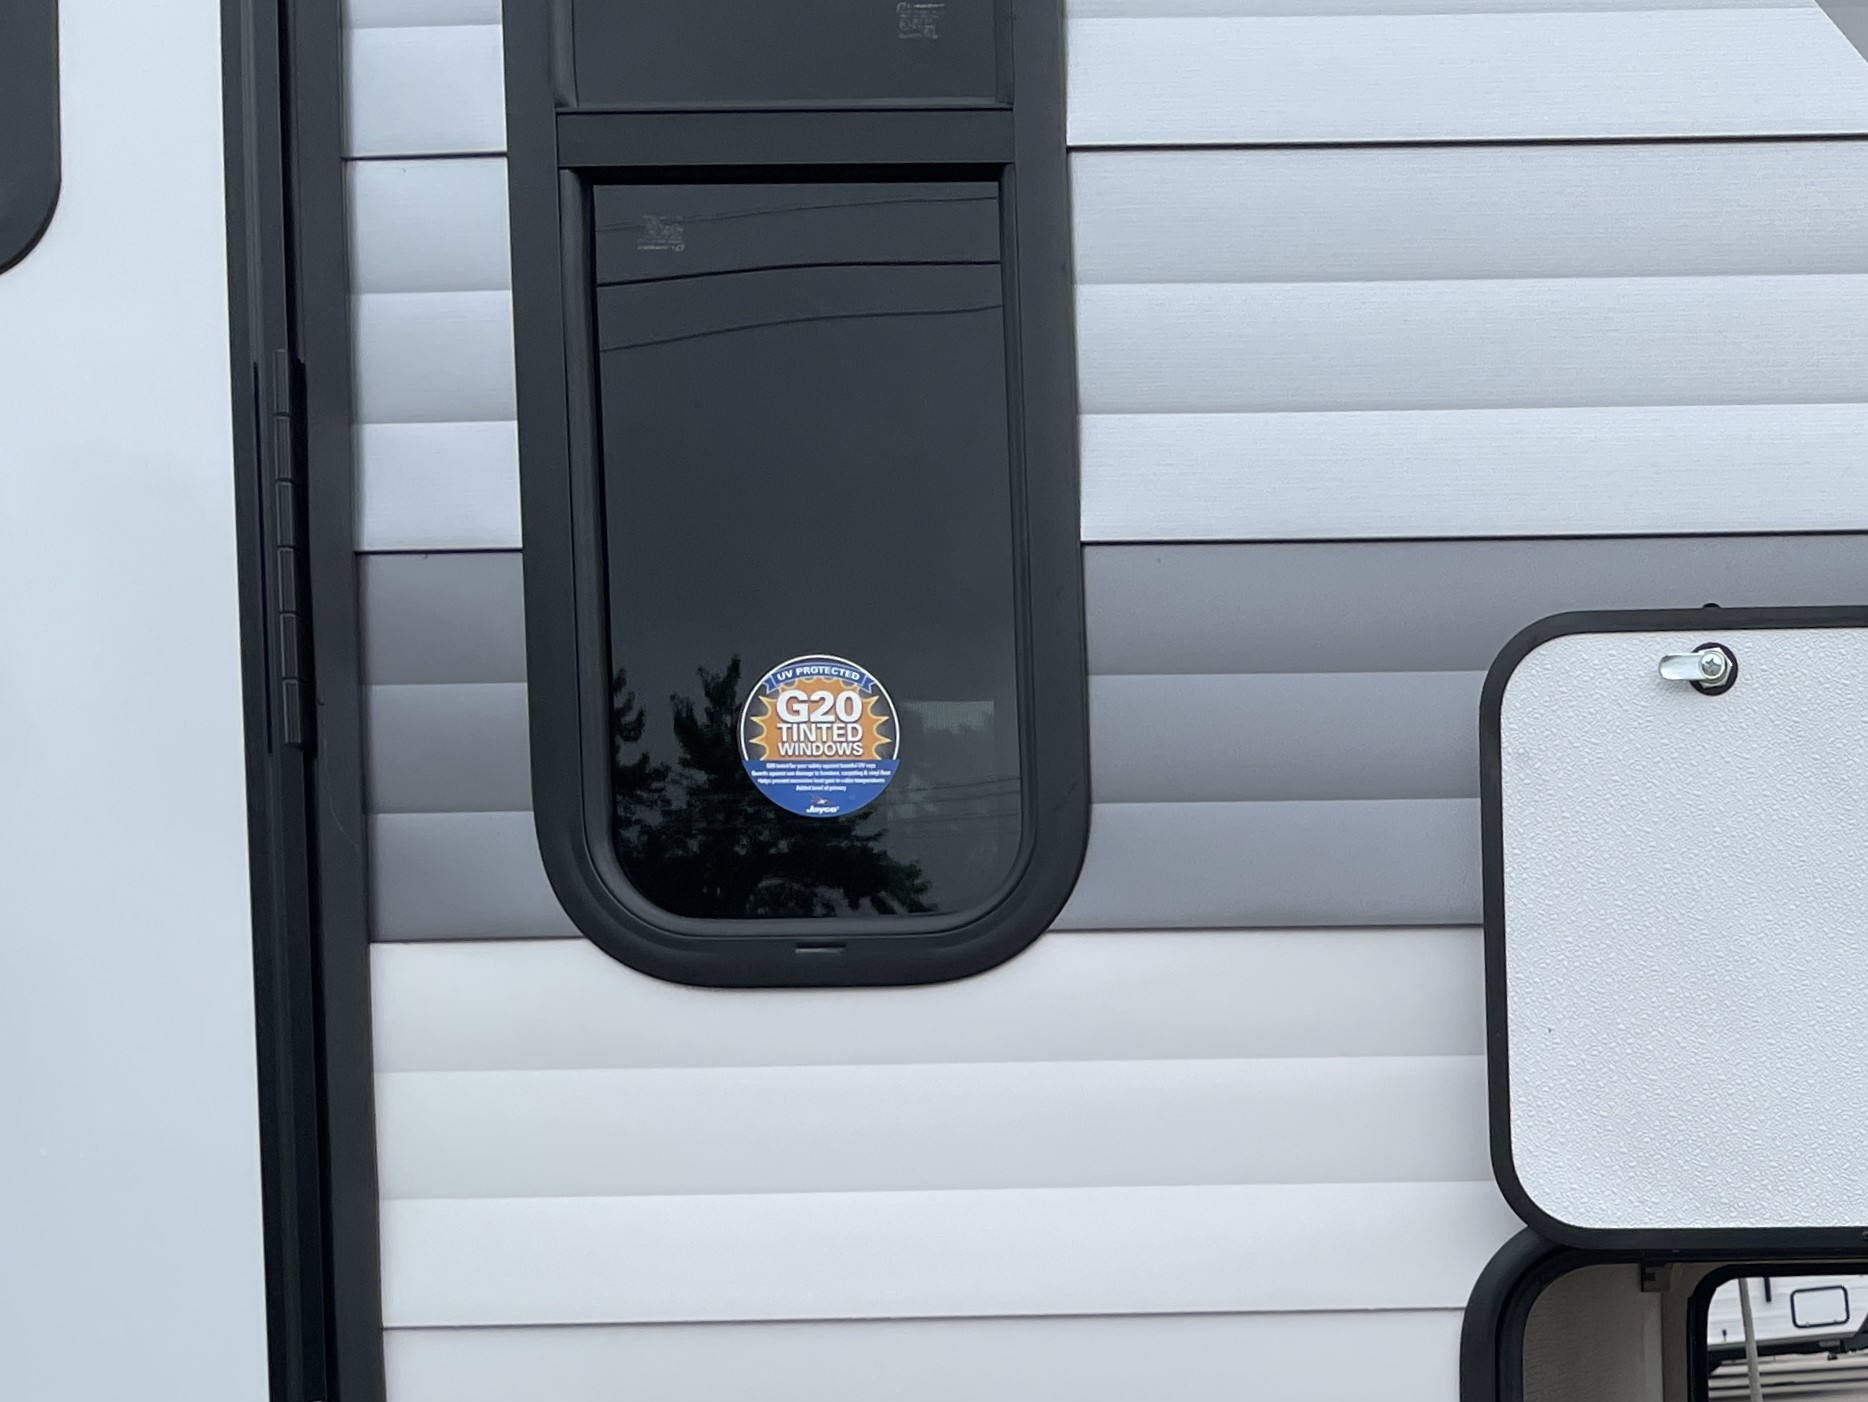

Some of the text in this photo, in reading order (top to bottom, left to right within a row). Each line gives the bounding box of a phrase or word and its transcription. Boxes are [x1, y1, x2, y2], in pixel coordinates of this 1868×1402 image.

[776, 666, 860, 681] UV PROTECTED
[776, 689, 863, 723] G20
[776, 723, 863, 742] TINTED
[777, 742, 864, 757] WINDOWS
[805, 805, 837, 815] Jayco
